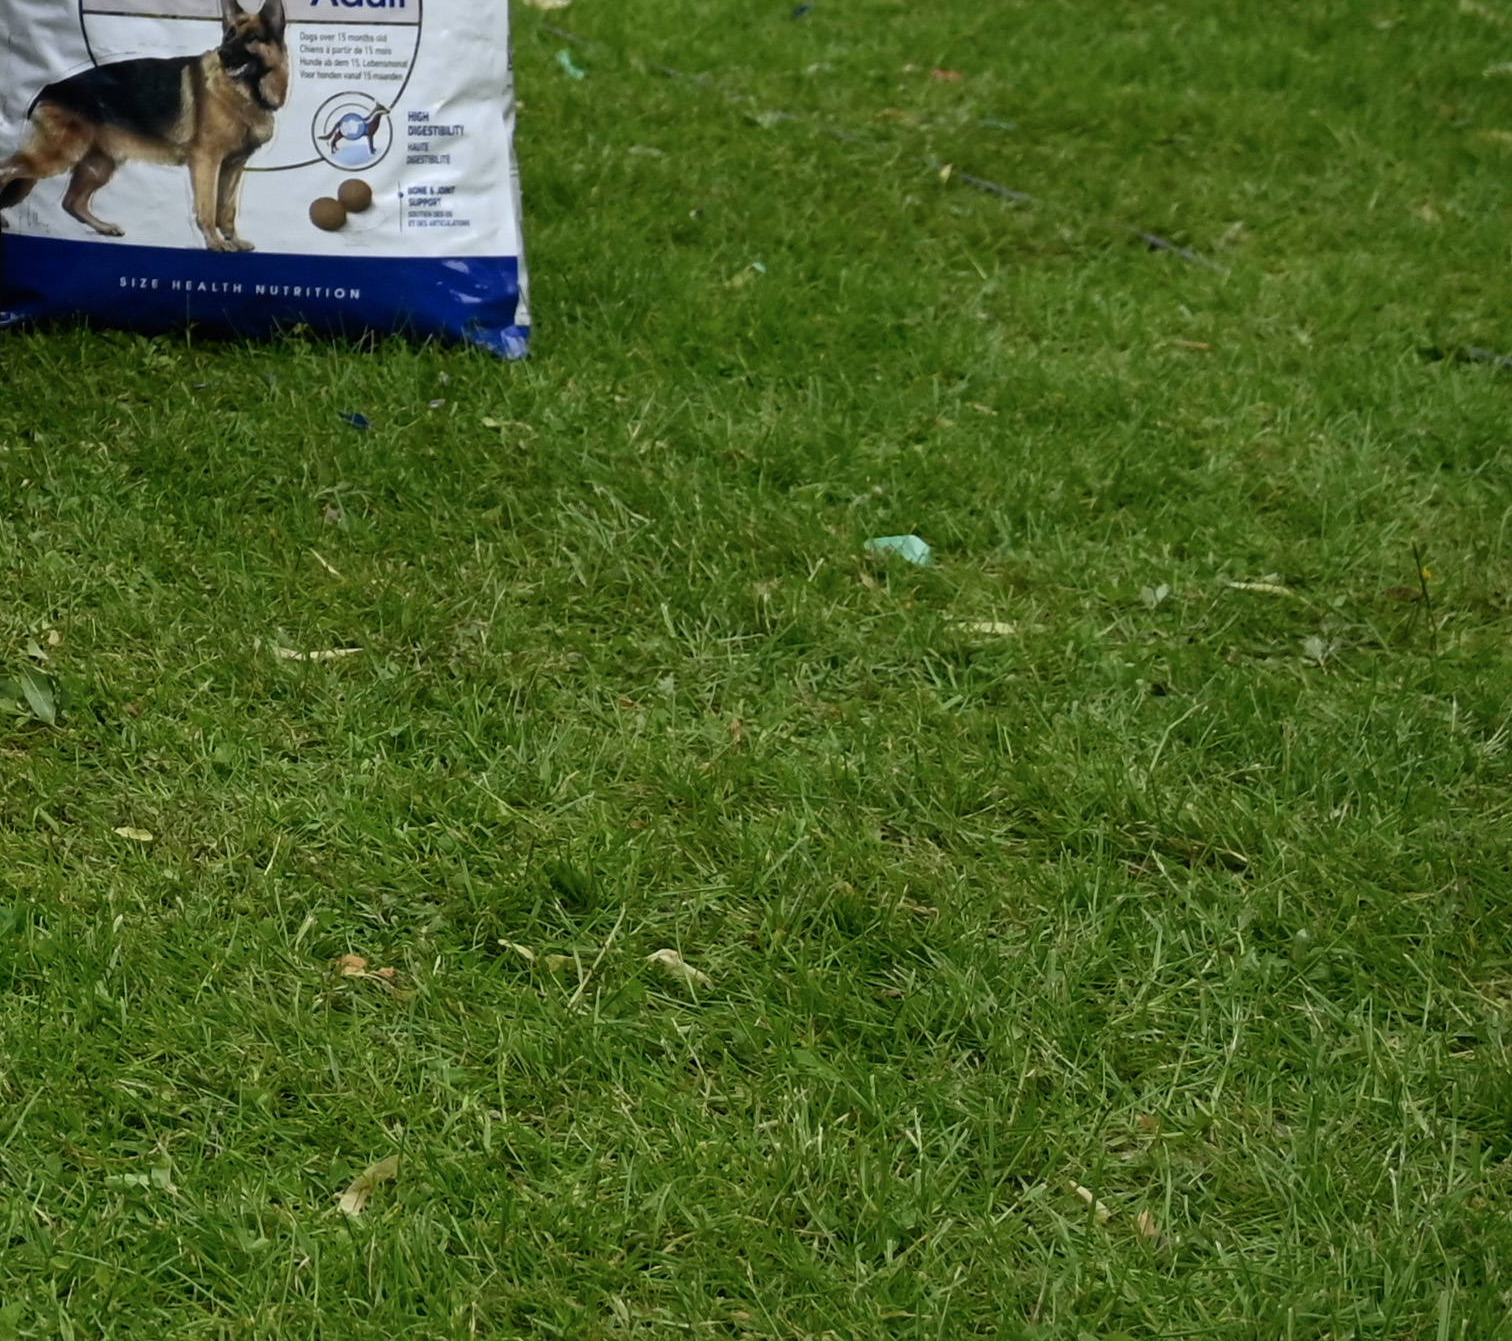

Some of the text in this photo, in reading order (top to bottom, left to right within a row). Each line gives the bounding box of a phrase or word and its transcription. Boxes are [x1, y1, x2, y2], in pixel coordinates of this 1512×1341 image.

[300, 32, 318, 42] Dogs
[338, 32, 346, 42] 15
[365, 46, 373, 55] 15
[407, 124, 465, 137] DIGESTIBILITY
[119, 276, 360, 299] SIZE HEALTH NUTRITION
